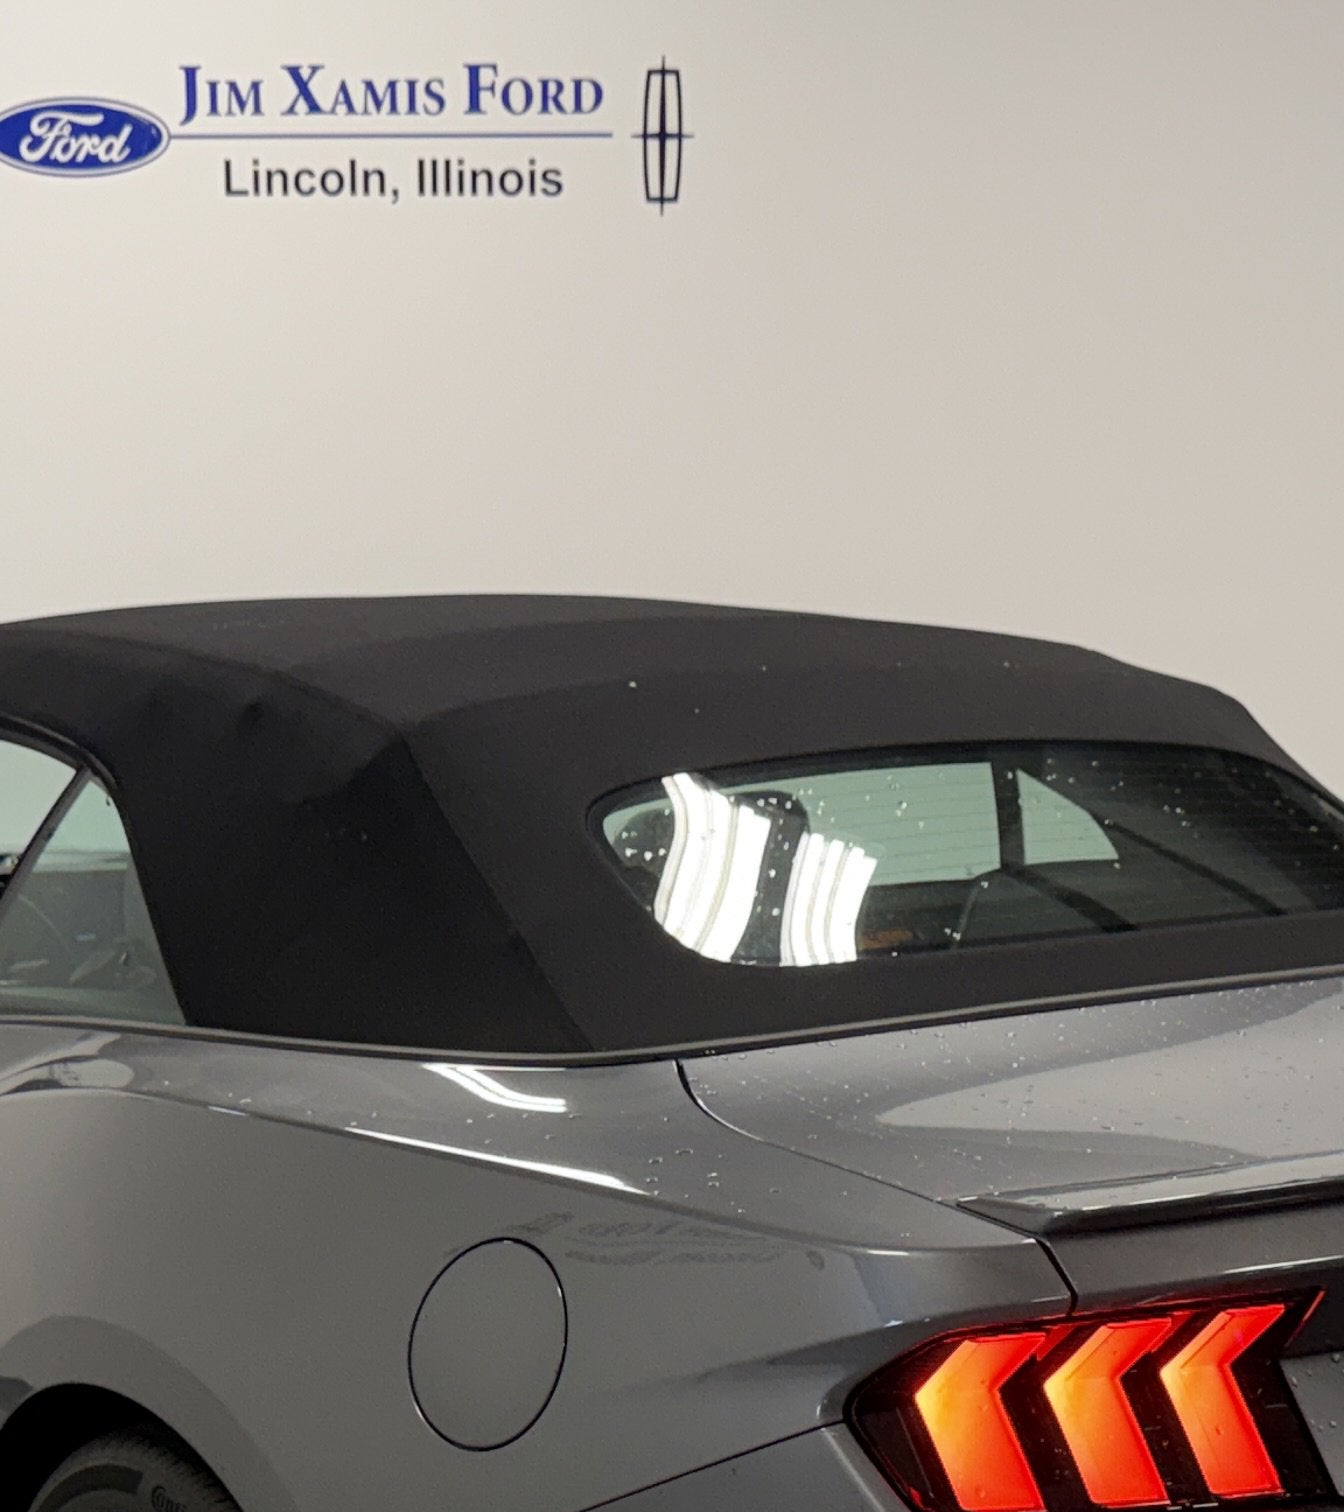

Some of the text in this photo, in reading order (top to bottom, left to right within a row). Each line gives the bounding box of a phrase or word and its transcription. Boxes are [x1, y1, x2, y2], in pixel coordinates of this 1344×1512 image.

[179, 63, 604, 125] JIM XAMIS FORD
[18, 109, 134, 163] Ford
[224, 158, 564, 204] Lincoln, Illinois
